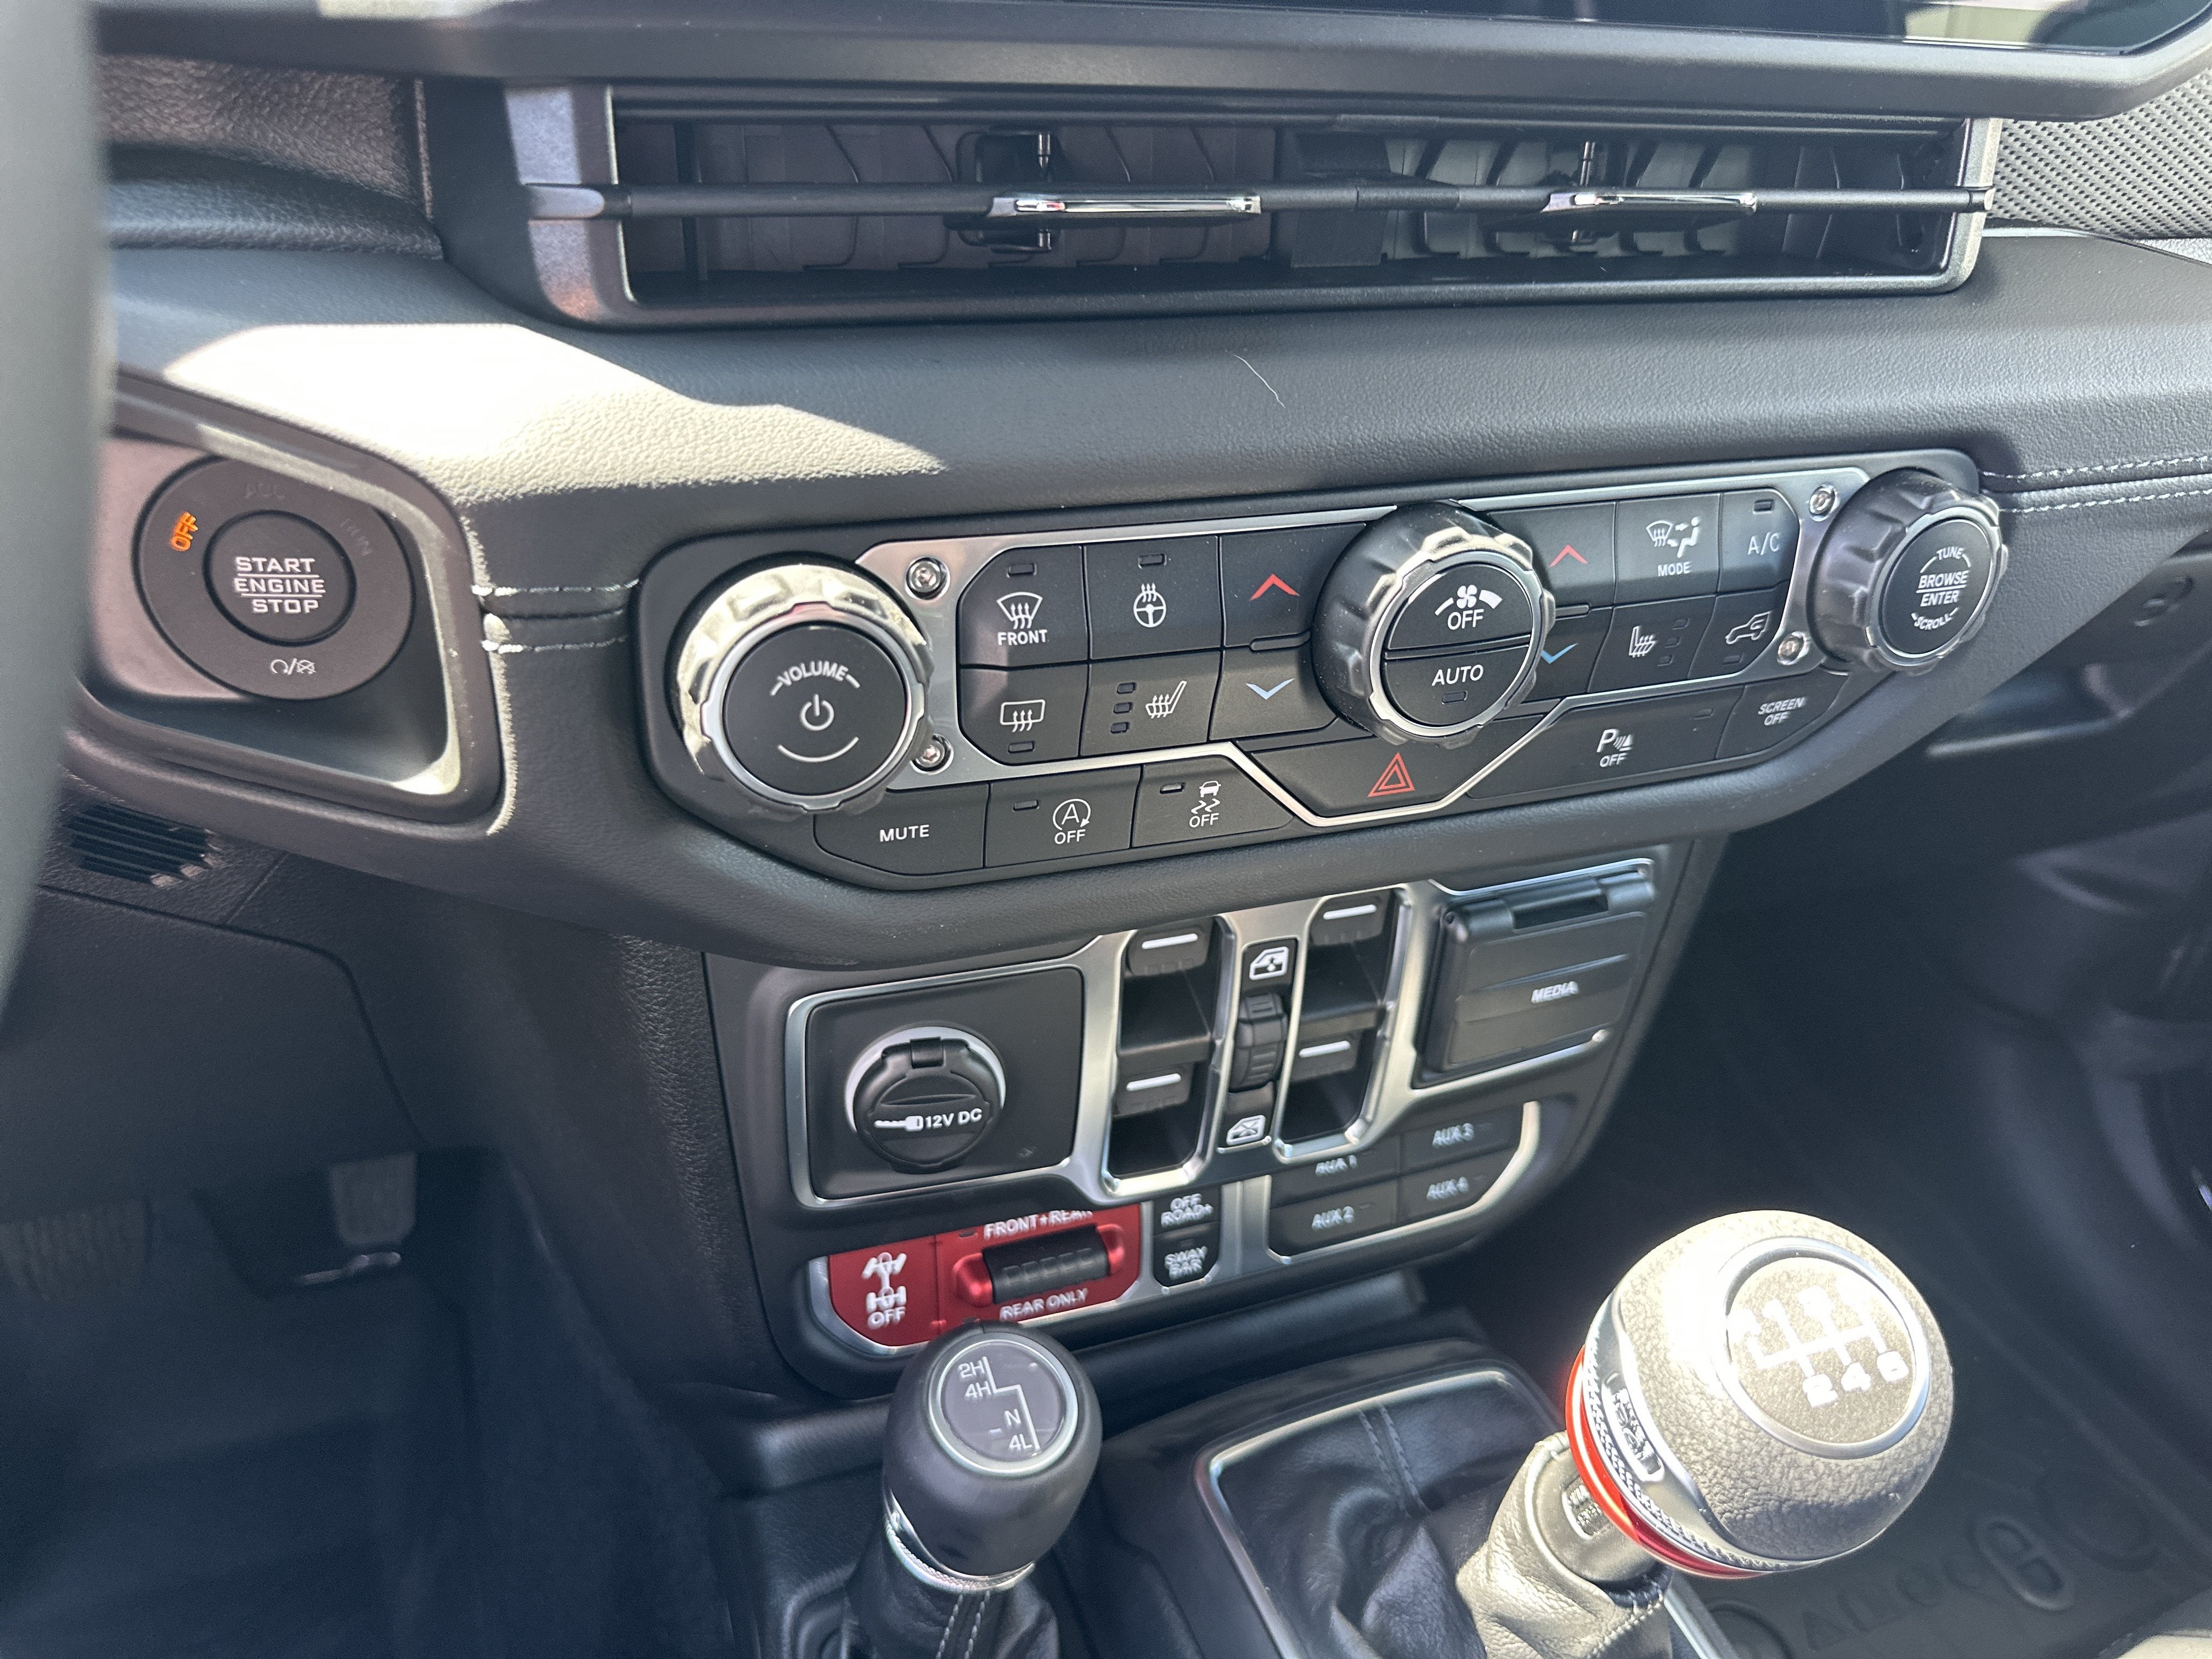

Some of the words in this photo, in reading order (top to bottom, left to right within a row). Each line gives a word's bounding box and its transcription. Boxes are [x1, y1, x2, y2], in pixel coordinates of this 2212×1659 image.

[170, 511, 199, 552] OFF
[1747, 532, 1780, 556] A/C
[1936, 546, 1965, 561] TUNE
[235, 556, 315, 573] START
[1657, 561, 1691, 577] MODE
[233, 577, 326, 594] ENGINE
[1918, 569, 1970, 589] BROWSE
[252, 599, 319, 614] STOP
[1920, 589, 1960, 607] ENTER
[1447, 608, 1485, 631] OFF
[1913, 610, 1953, 631] SCROLL
[997, 629, 1047, 646] FRONT
[778, 660, 849, 687] VOLUME
[1431, 663, 1484, 687] AUTO
[1757, 695, 1807, 715] SCREEN
[1763, 710, 1791, 726] OFF
[1599, 751, 1628, 768] OFF
[1189, 812, 1220, 828] OFF
[879, 823, 930, 843] MUTE
[1054, 828, 1086, 845] OFF
[1530, 980, 1579, 1003] MEDIA
[925, 1111, 954, 1128] 12V
[957, 1108, 983, 1125] DC
[1170, 1193, 1202, 1212] OFF
[1169, 1258, 1203, 1280] BAR
[999, 1298, 1045, 1322] REAR
[1045, 1288, 1088, 1310] ONLY
[867, 1305, 907, 1329] OFF
[957, 1359, 986, 1380] 2H
[1841, 1362, 1871, 1392] 4
[964, 1380, 992, 1401] 4H
[1802, 1374, 1839, 1408] 2
[1004, 1408, 1022, 1428] N
[1008, 1433, 1033, 1452] 4L
